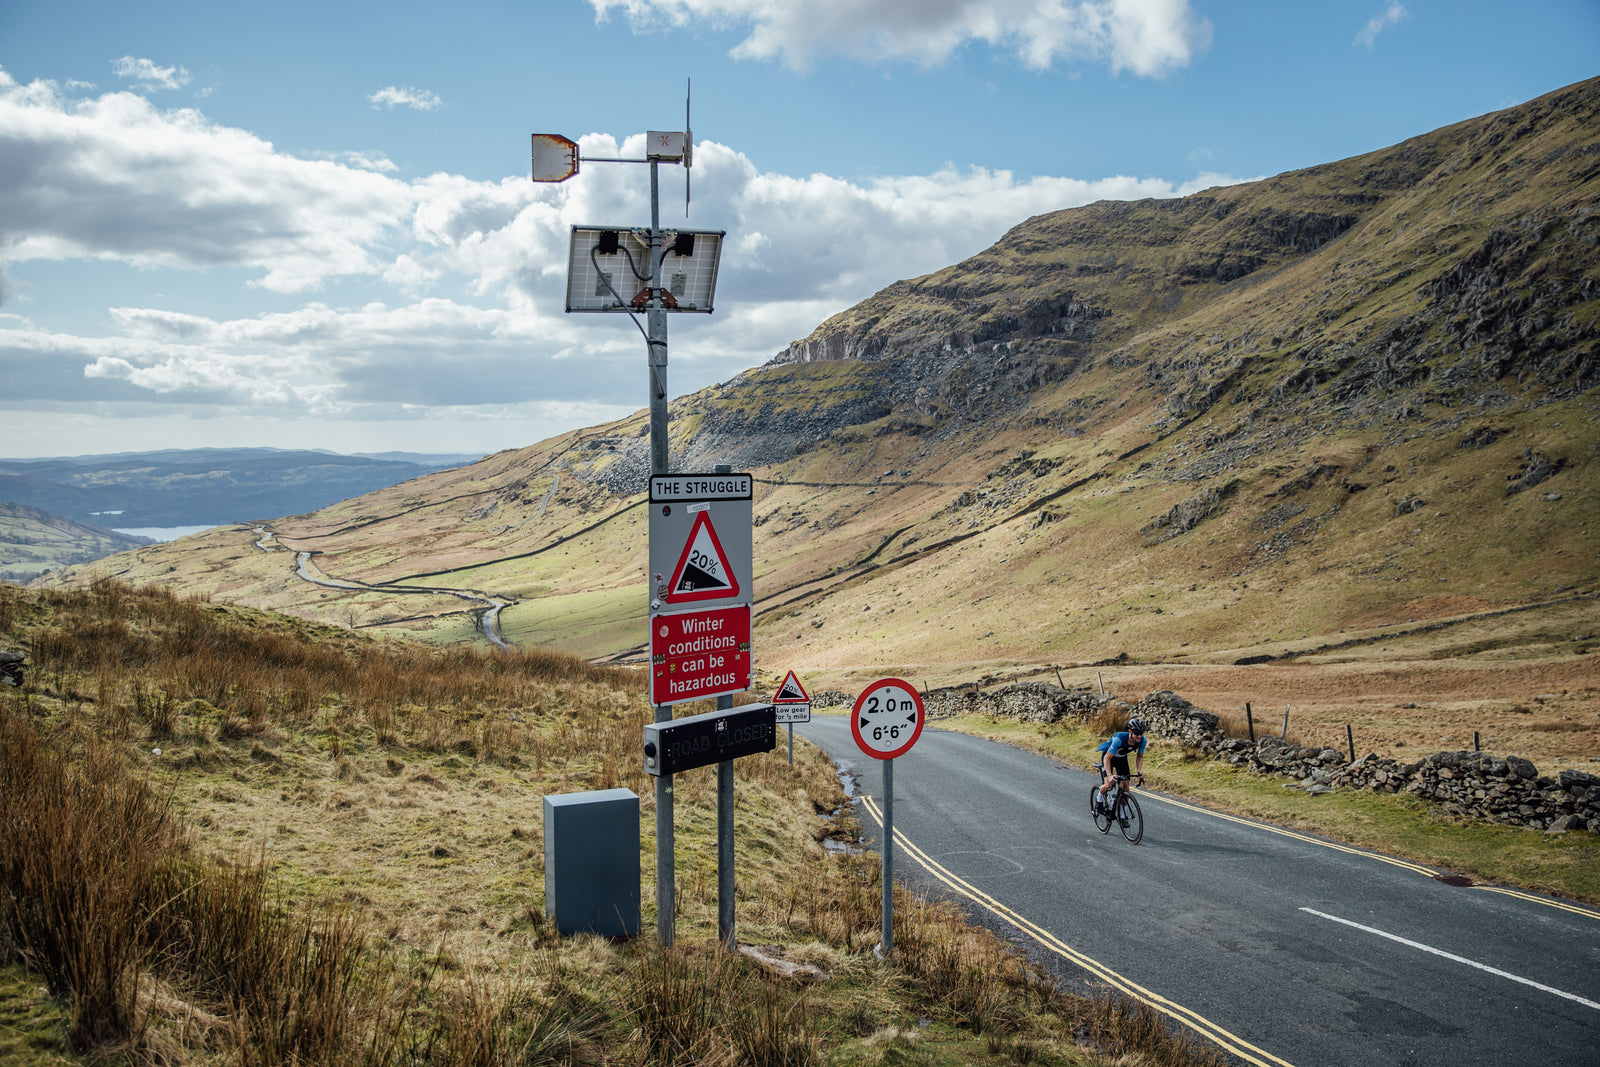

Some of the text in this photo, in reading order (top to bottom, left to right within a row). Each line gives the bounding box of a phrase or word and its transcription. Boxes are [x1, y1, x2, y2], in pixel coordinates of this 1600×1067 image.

[656, 481, 747, 494] THE STRUGGLE
[690, 550, 718, 574] 20%
[682, 616, 724, 634] Winter
[668, 634, 736, 655] conditions
[682, 658, 705, 672] can
[709, 654, 724, 668] be
[670, 672, 736, 694] hazardous
[784, 684, 798, 694] 20%
[868, 696, 912, 714] 2.0 m
[672, 736, 710, 758] ROAD
[717, 723, 768, 748] CLOSED
